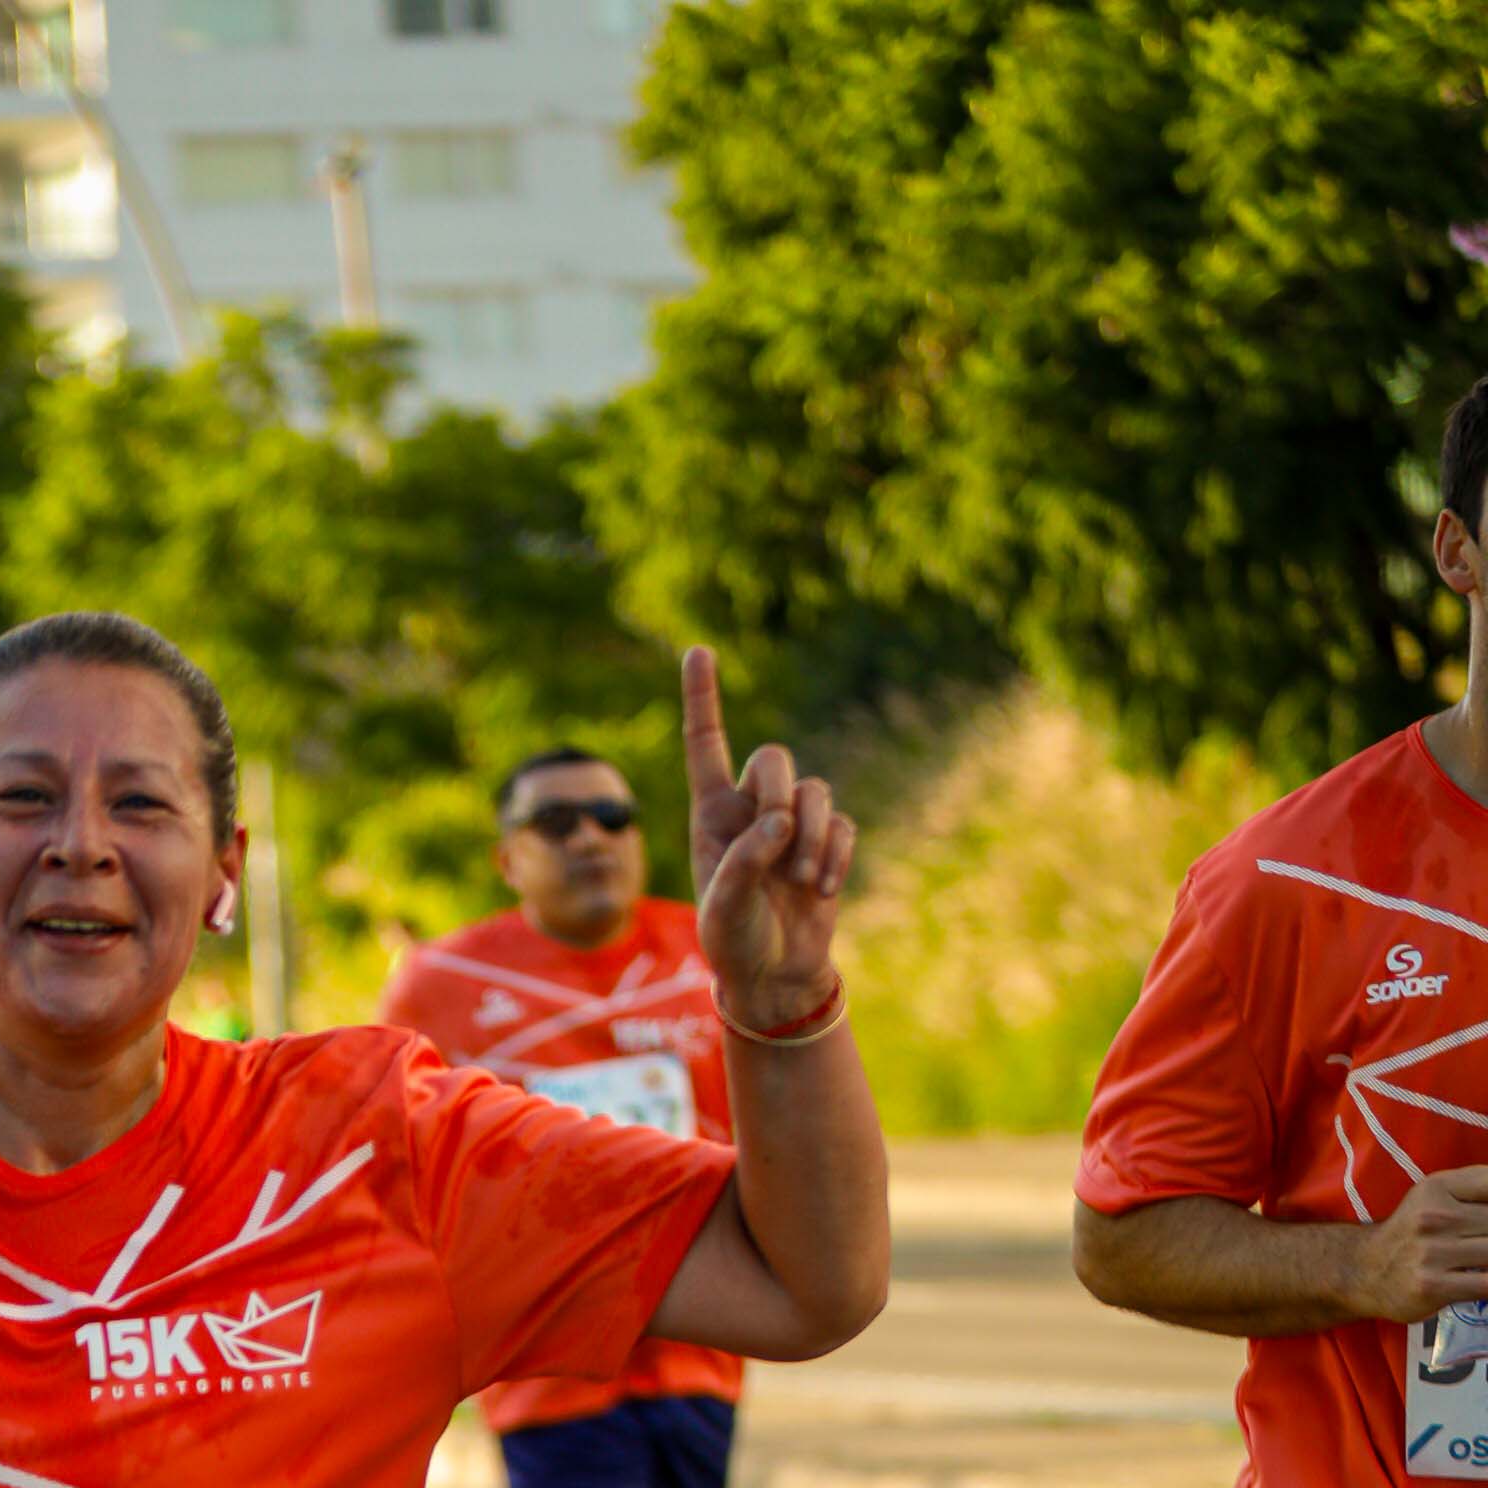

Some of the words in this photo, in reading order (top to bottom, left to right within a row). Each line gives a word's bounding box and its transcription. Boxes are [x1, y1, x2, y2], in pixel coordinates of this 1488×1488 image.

[75, 1314, 206, 1380] 15K
[90, 1378, 210, 1401] PUERTO
[220, 1371, 311, 1392] NORTE
